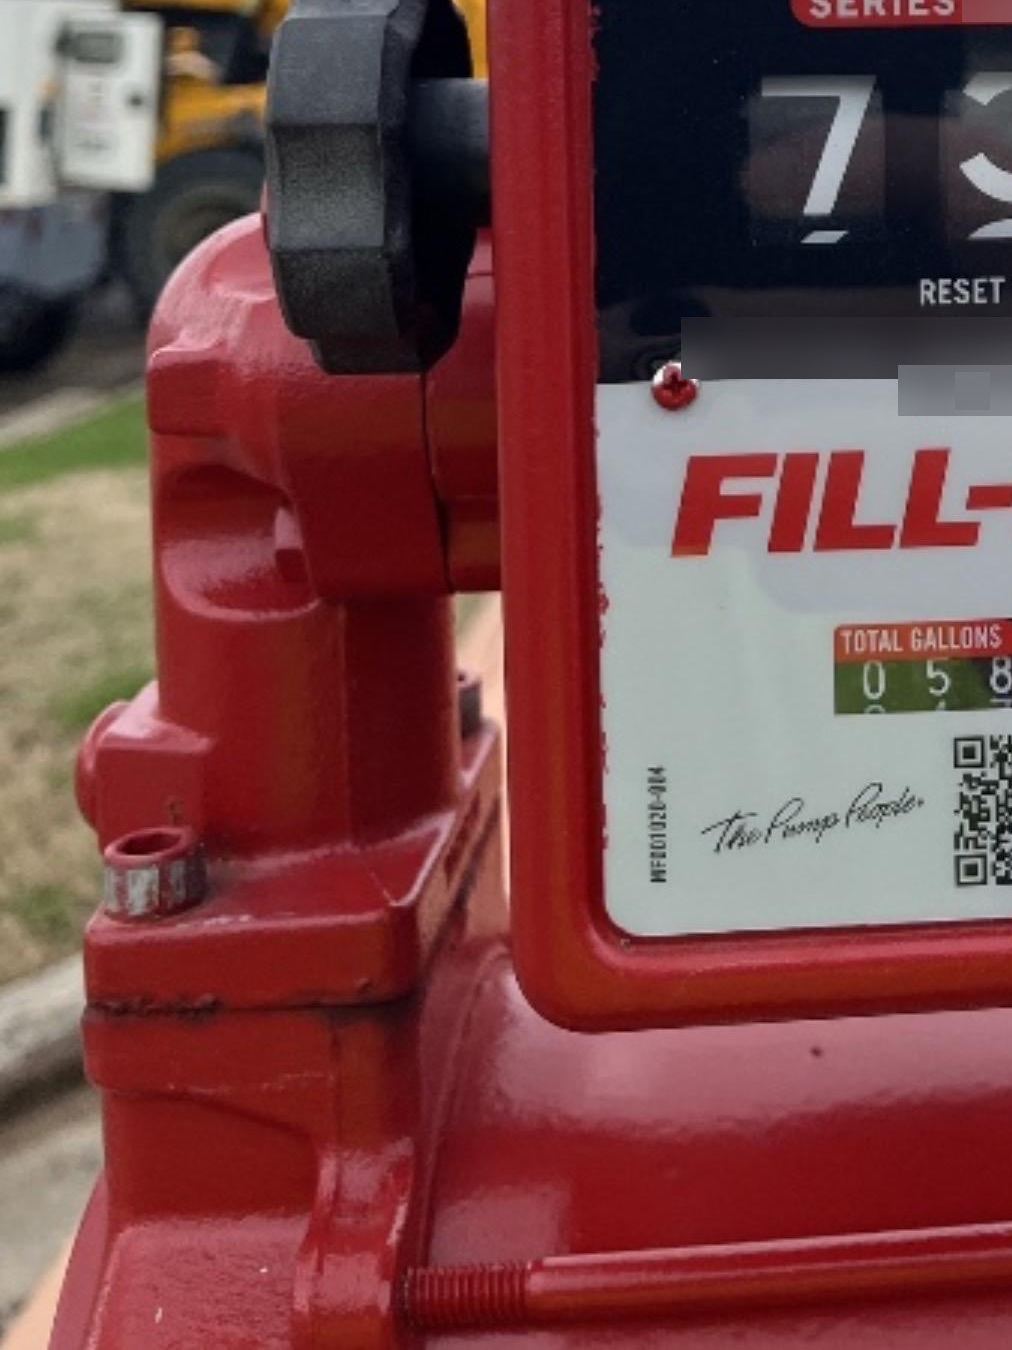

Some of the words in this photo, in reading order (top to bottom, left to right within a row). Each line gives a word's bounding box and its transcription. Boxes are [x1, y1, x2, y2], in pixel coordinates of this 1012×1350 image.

[920, 277, 1005, 306] RESET
[840, 629, 902, 654] TOTAL
[911, 624, 1001, 651] GALLONS
